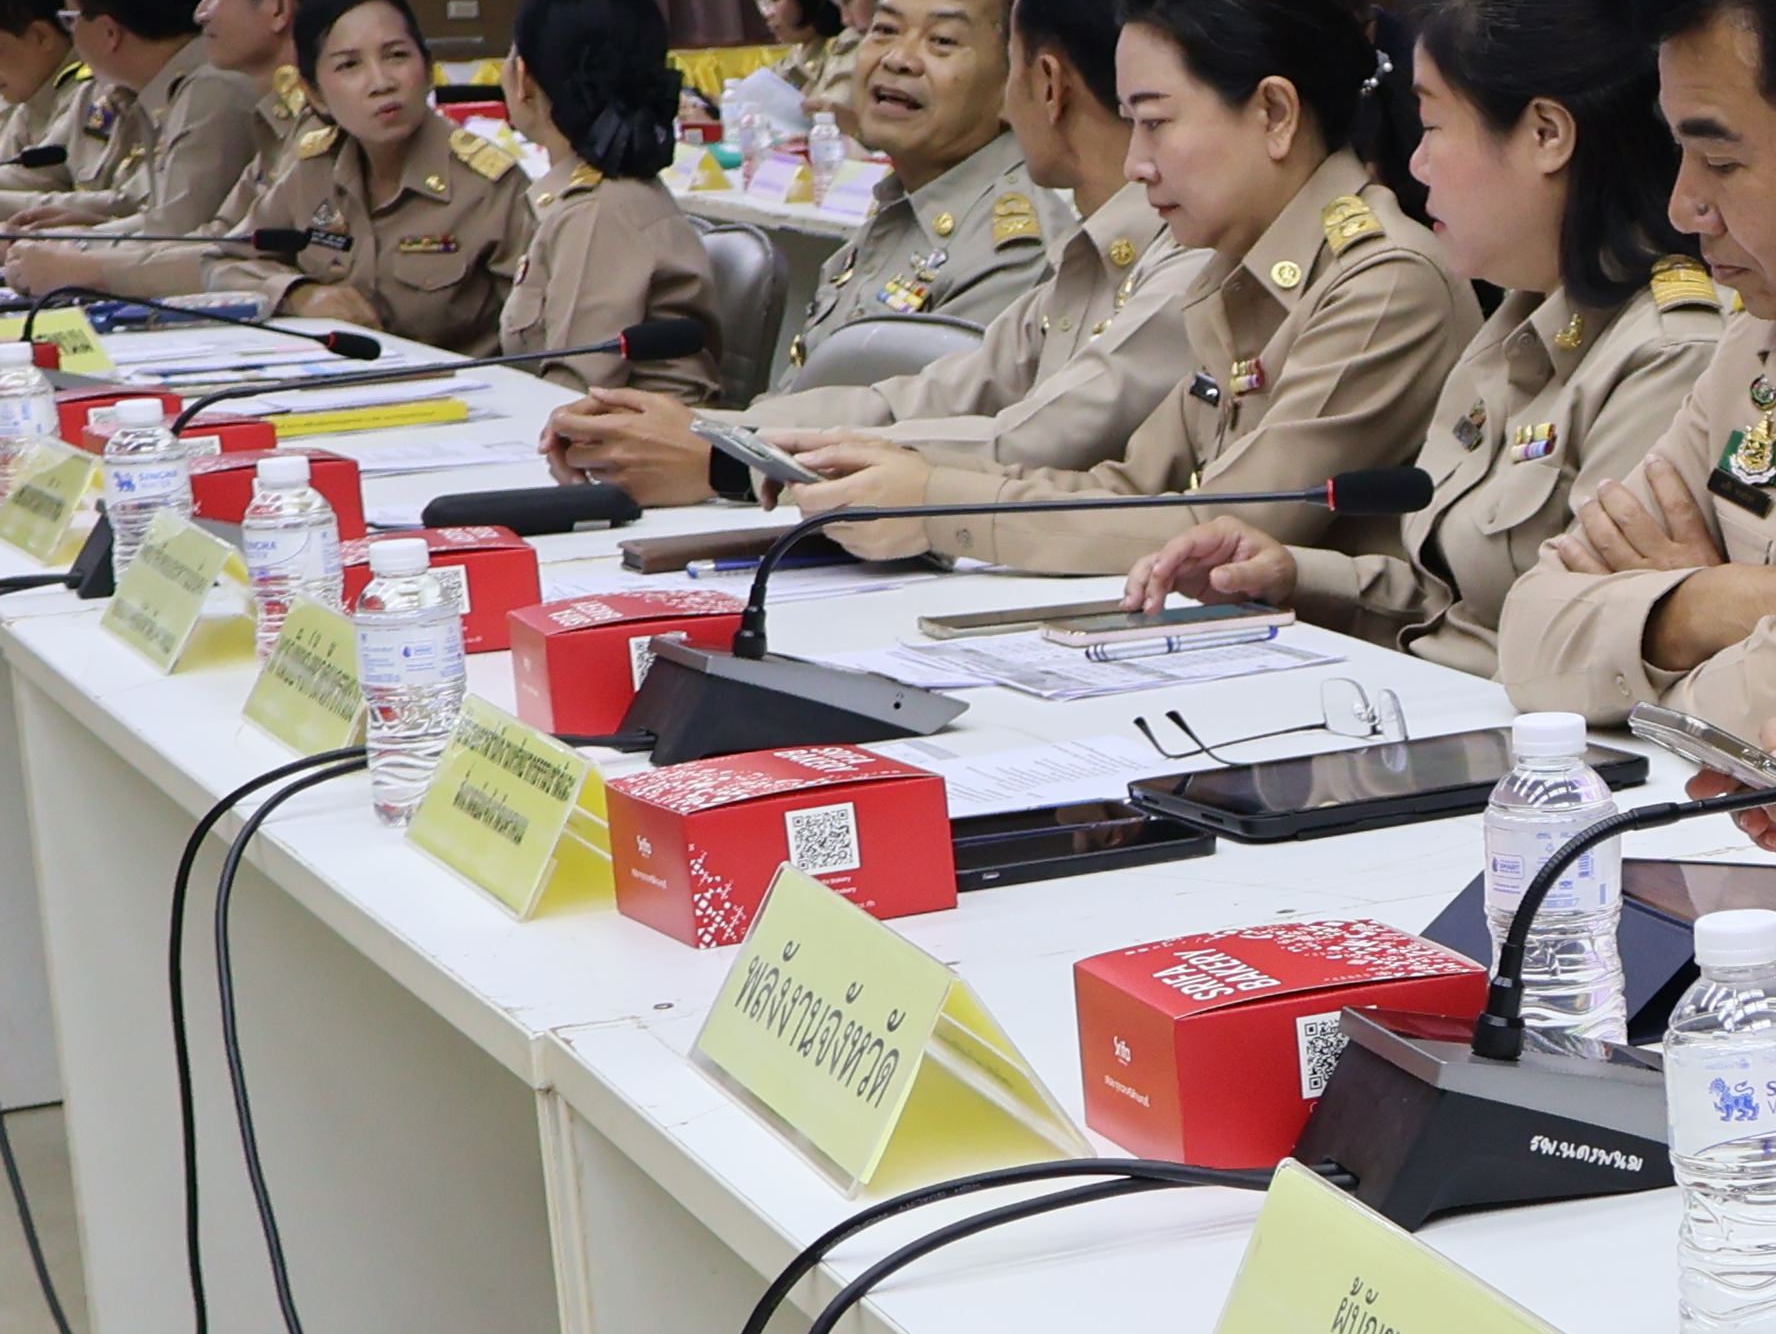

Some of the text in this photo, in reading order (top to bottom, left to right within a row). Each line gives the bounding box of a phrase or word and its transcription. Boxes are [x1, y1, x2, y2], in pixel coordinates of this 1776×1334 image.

[1152, 964, 1235, 1000] SRIFA
[1172, 948, 1282, 991] BAKERY
[735, 940, 905, 1109] พลังงานจังหวัด
